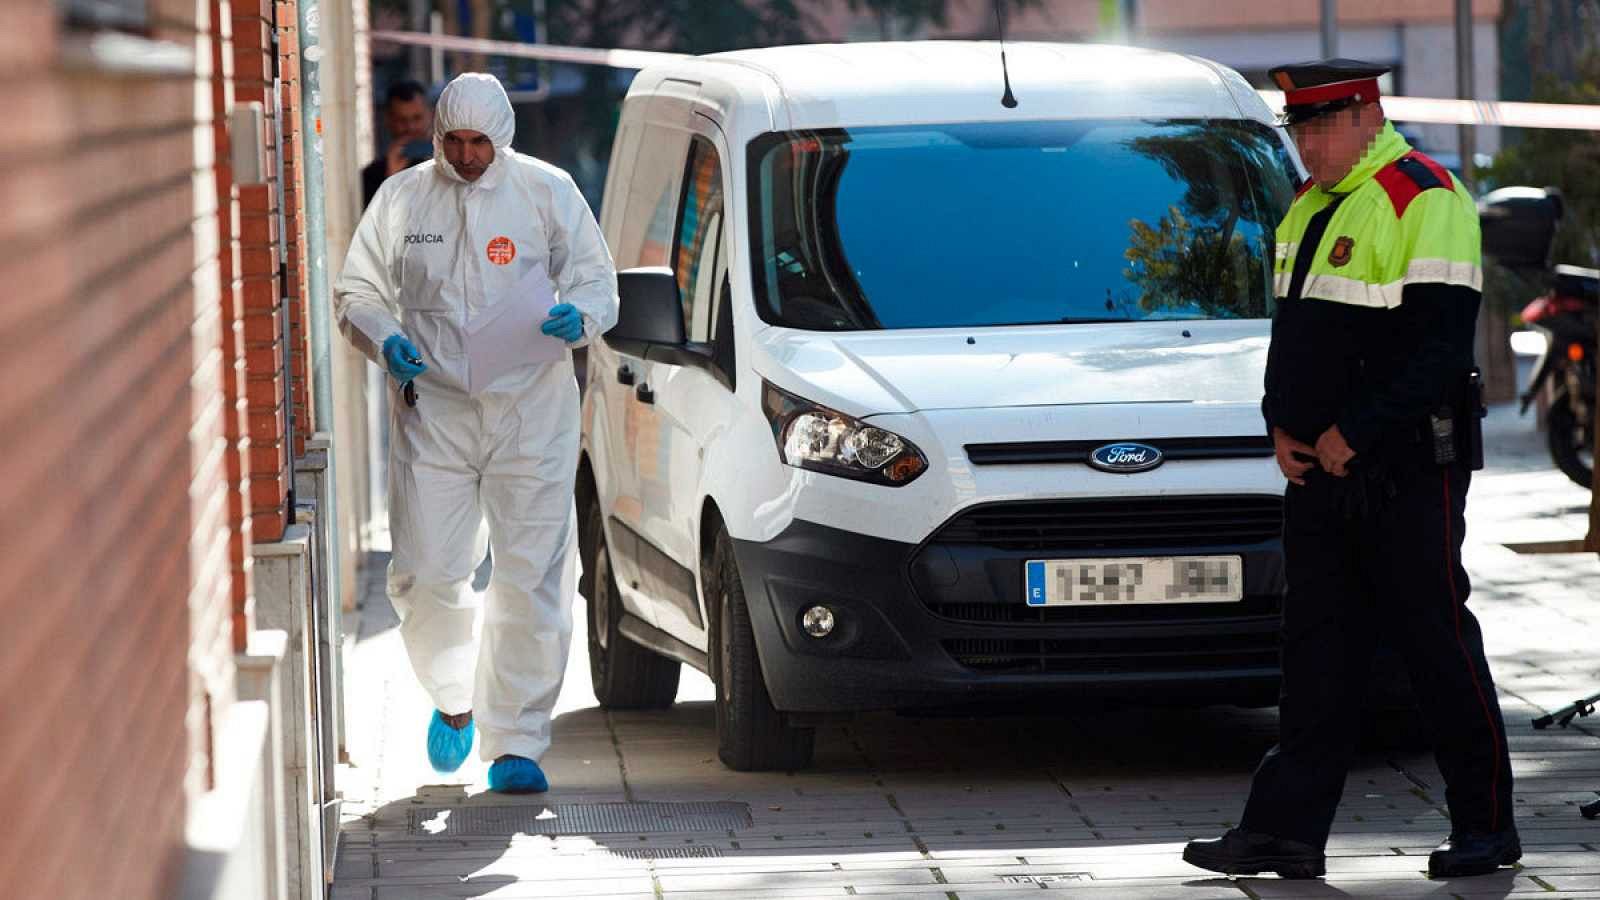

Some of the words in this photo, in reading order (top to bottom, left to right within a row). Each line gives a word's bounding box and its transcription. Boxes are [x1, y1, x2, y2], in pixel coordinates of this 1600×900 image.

[404, 234, 443, 244] POLICIA
[1107, 447, 1146, 463] Ford
[1033, 587, 1041, 598] E
